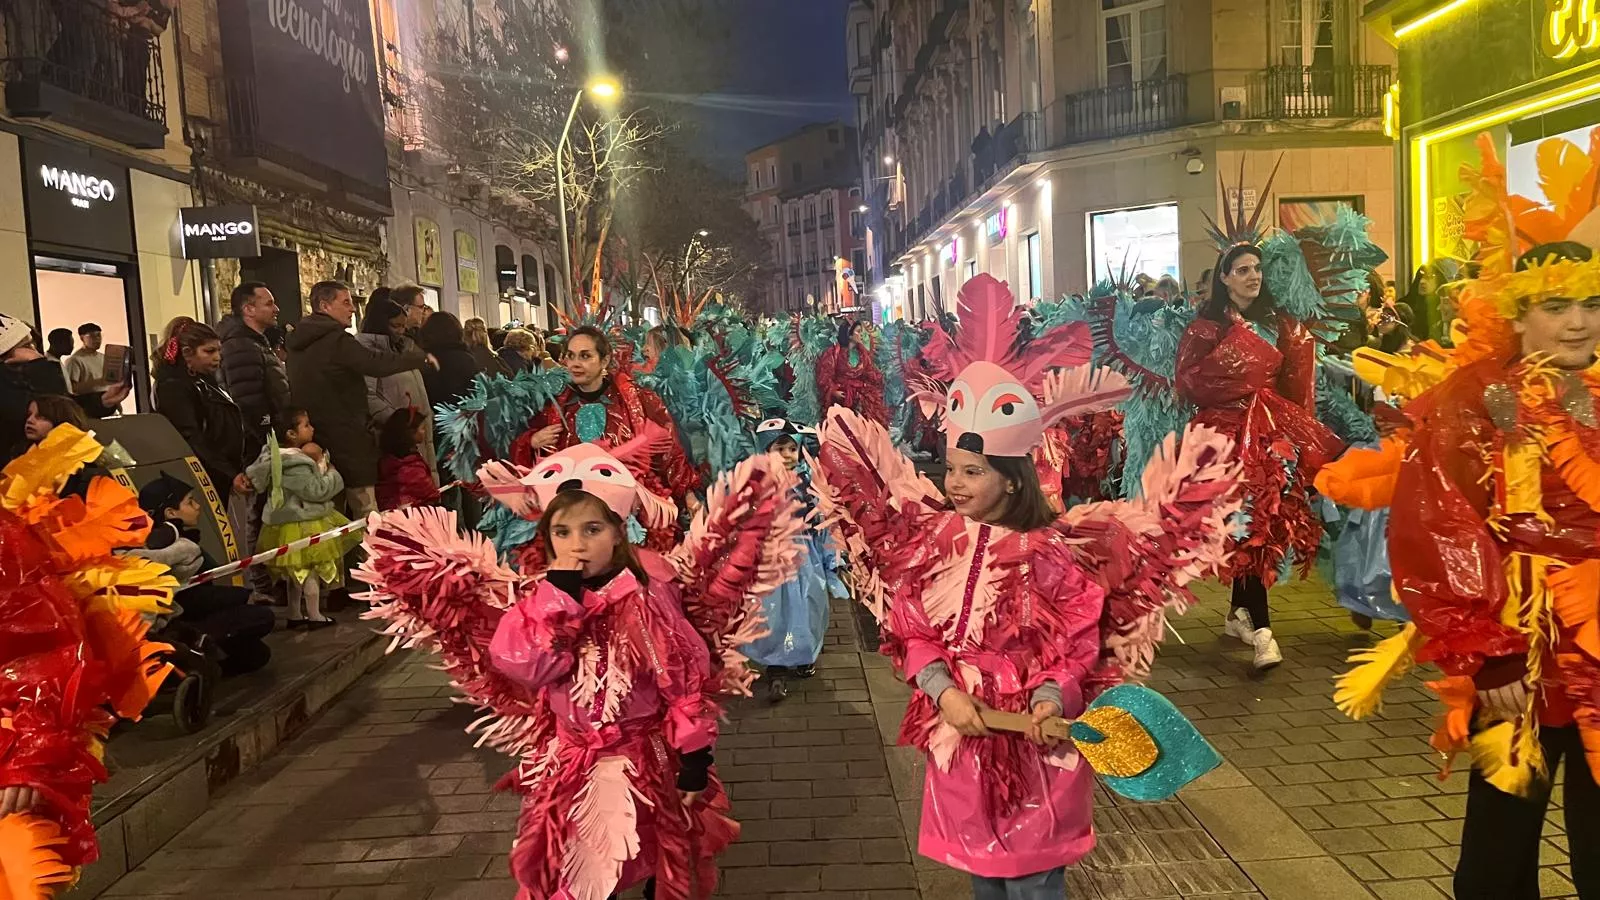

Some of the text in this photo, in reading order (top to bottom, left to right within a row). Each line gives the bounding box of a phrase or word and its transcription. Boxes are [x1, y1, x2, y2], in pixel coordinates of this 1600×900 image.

[41, 164, 115, 202] MANGO
[185, 221, 253, 237] MANGO
[189, 460, 239, 562] ENVASES
